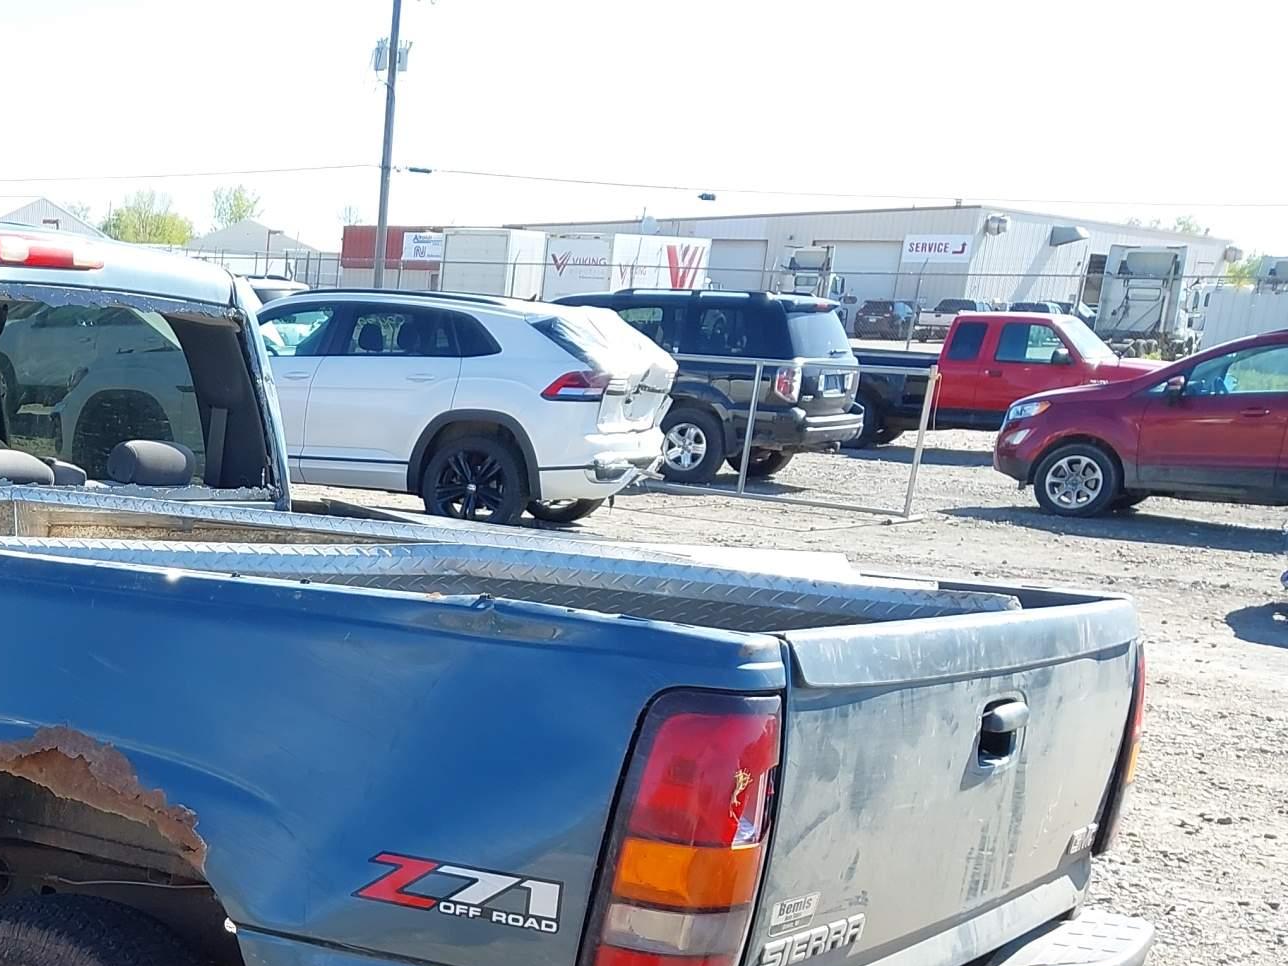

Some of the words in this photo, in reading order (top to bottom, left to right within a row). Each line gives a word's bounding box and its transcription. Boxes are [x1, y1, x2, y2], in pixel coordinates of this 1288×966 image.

[908, 242, 950, 253] SERVICE
[572, 256, 607, 266] VIKING
[352, 850, 564, 920] Z71
[438, 902, 481, 918] OFF
[491, 911, 557, 933] ROAD
